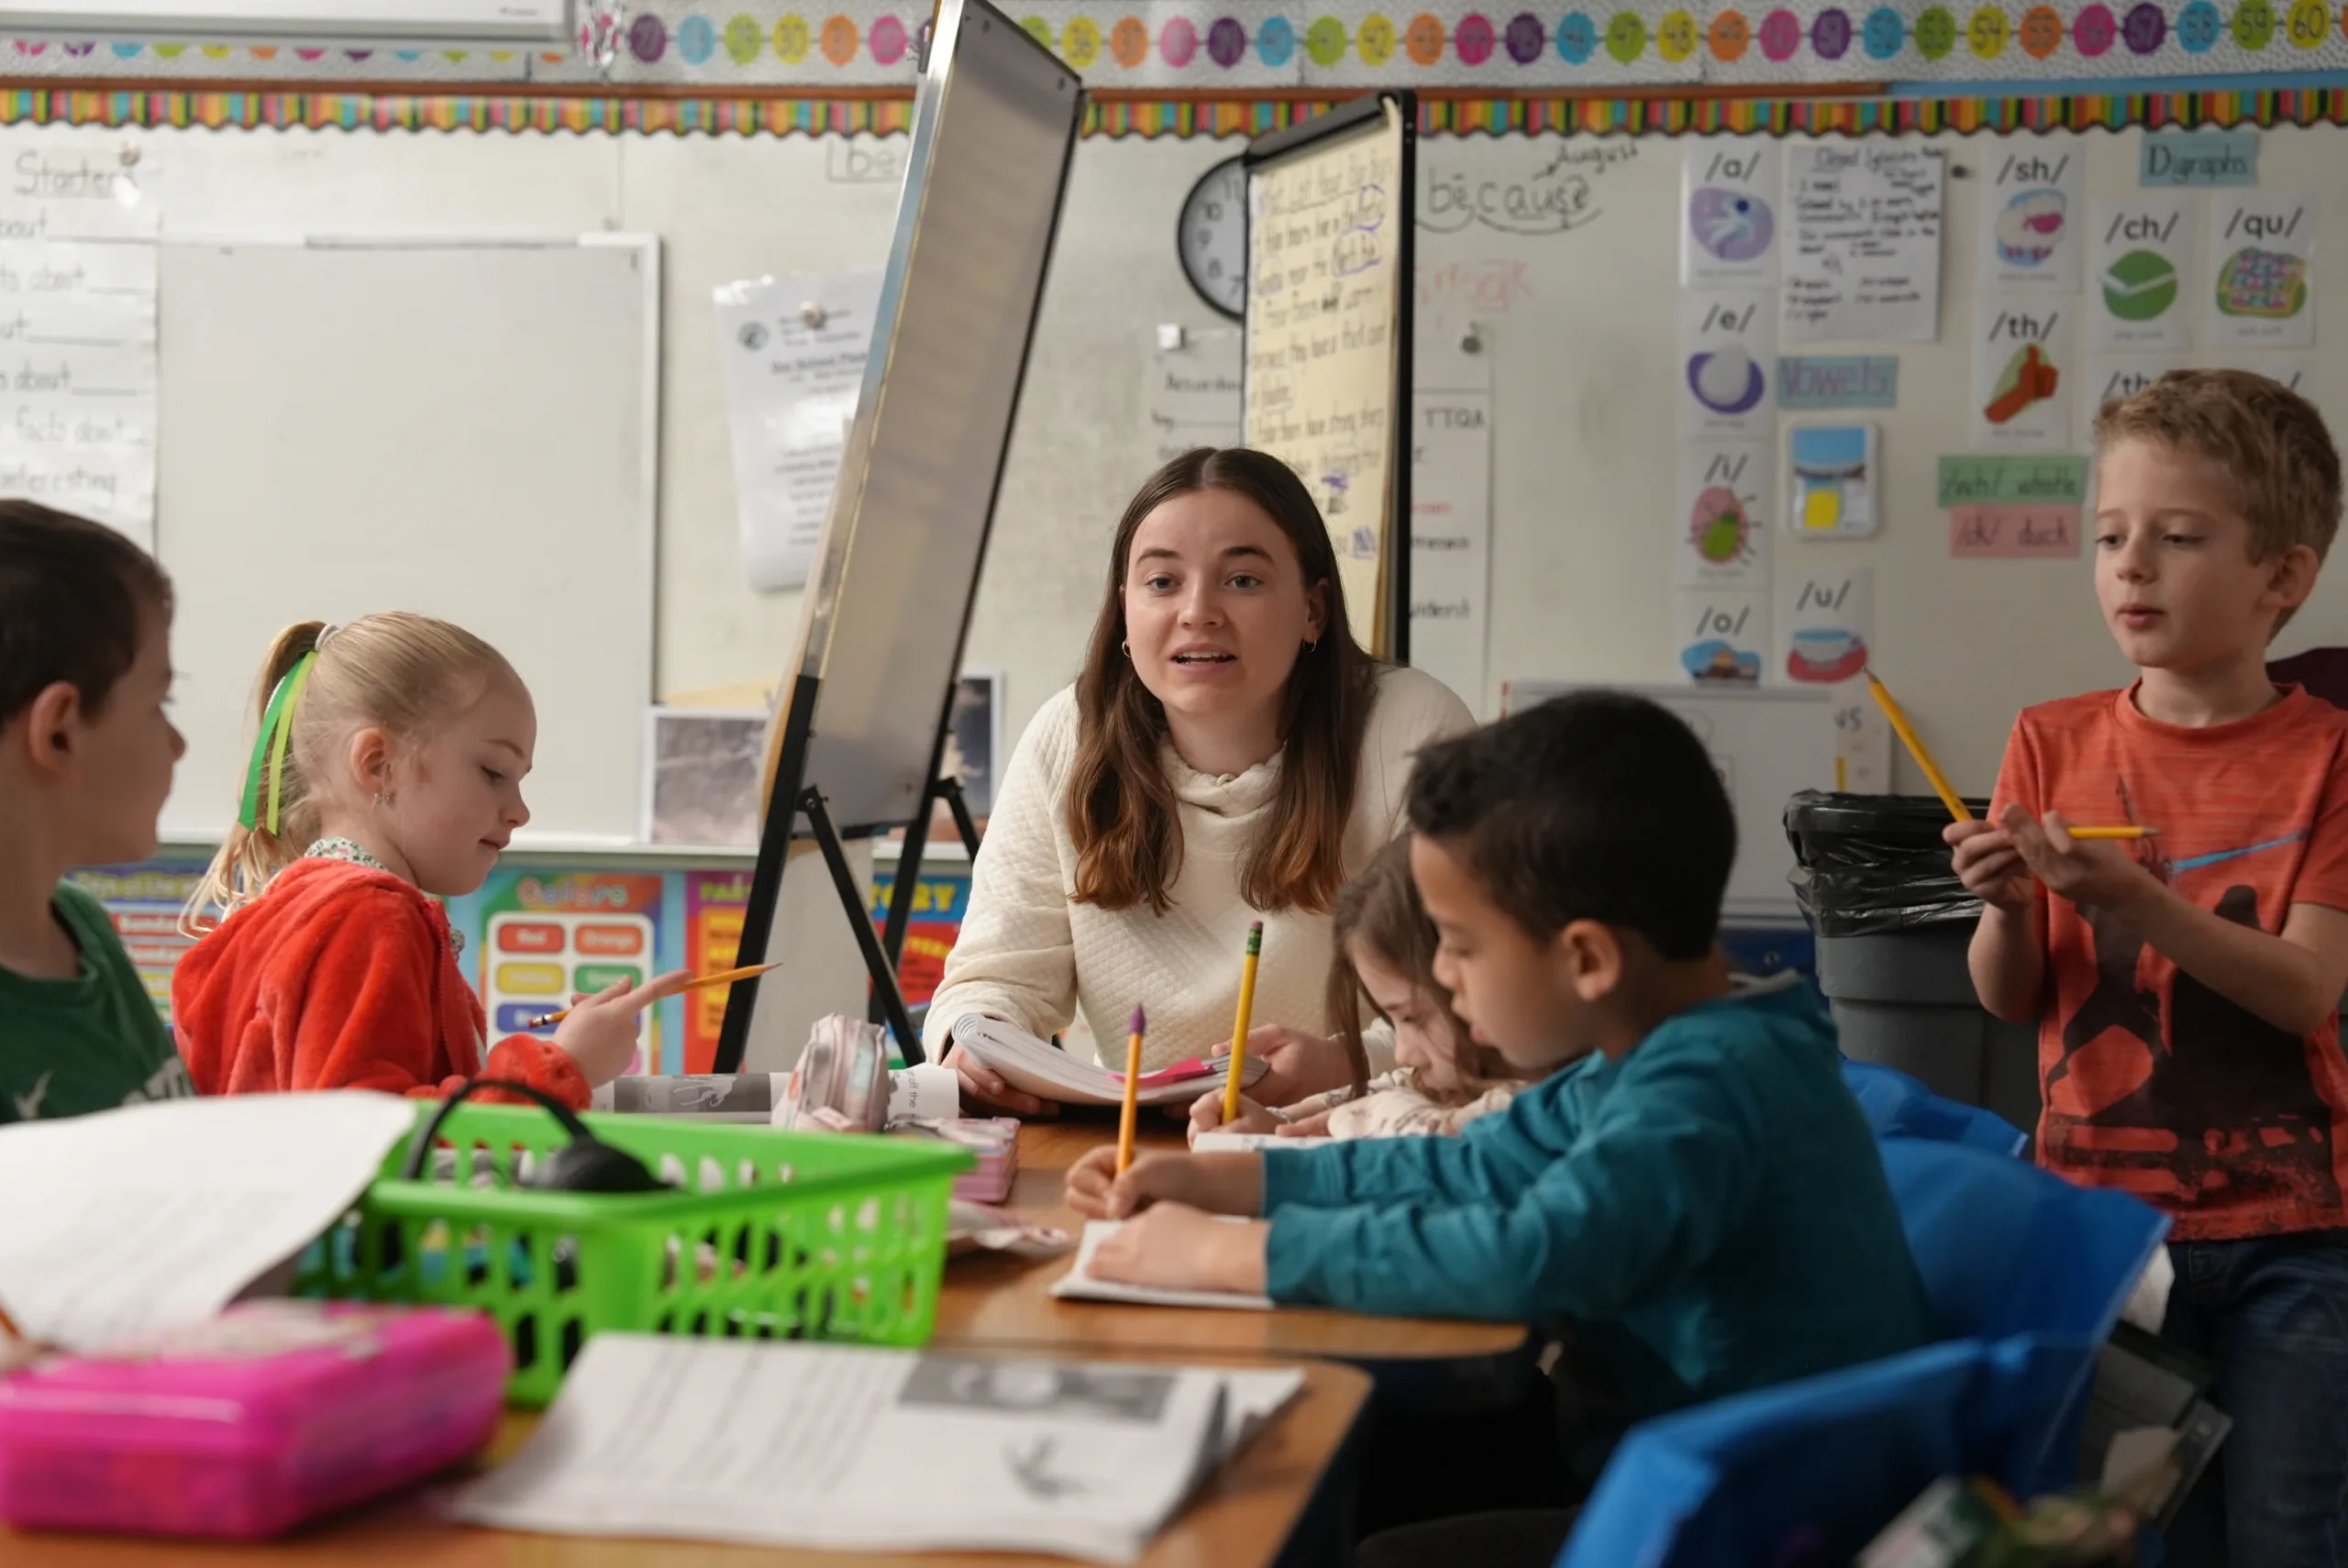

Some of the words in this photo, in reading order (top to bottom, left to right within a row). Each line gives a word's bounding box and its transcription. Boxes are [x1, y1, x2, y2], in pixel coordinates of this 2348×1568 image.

[1974, 16, 2001, 50] 54
[2241, 7, 2267, 41] 59
[2294, 5, 2324, 40] 60
[1705, 150, 1761, 183] /a/
[1996, 154, 2069, 185] /sh/
[2104, 211, 2179, 244] /ch/
[2224, 206, 2304, 240] /qu/
[1700, 303, 1756, 334] /e/
[1988, 311, 2059, 342] /th/
[1780, 356, 1888, 397] Vowels
[1796, 579, 1851, 612] /u/
[1695, 605, 1750, 637] /o/
[515, 877, 629, 909] Colors
[908, 1077, 919, 1088] off
[908, 1091, 919, 1109] the
